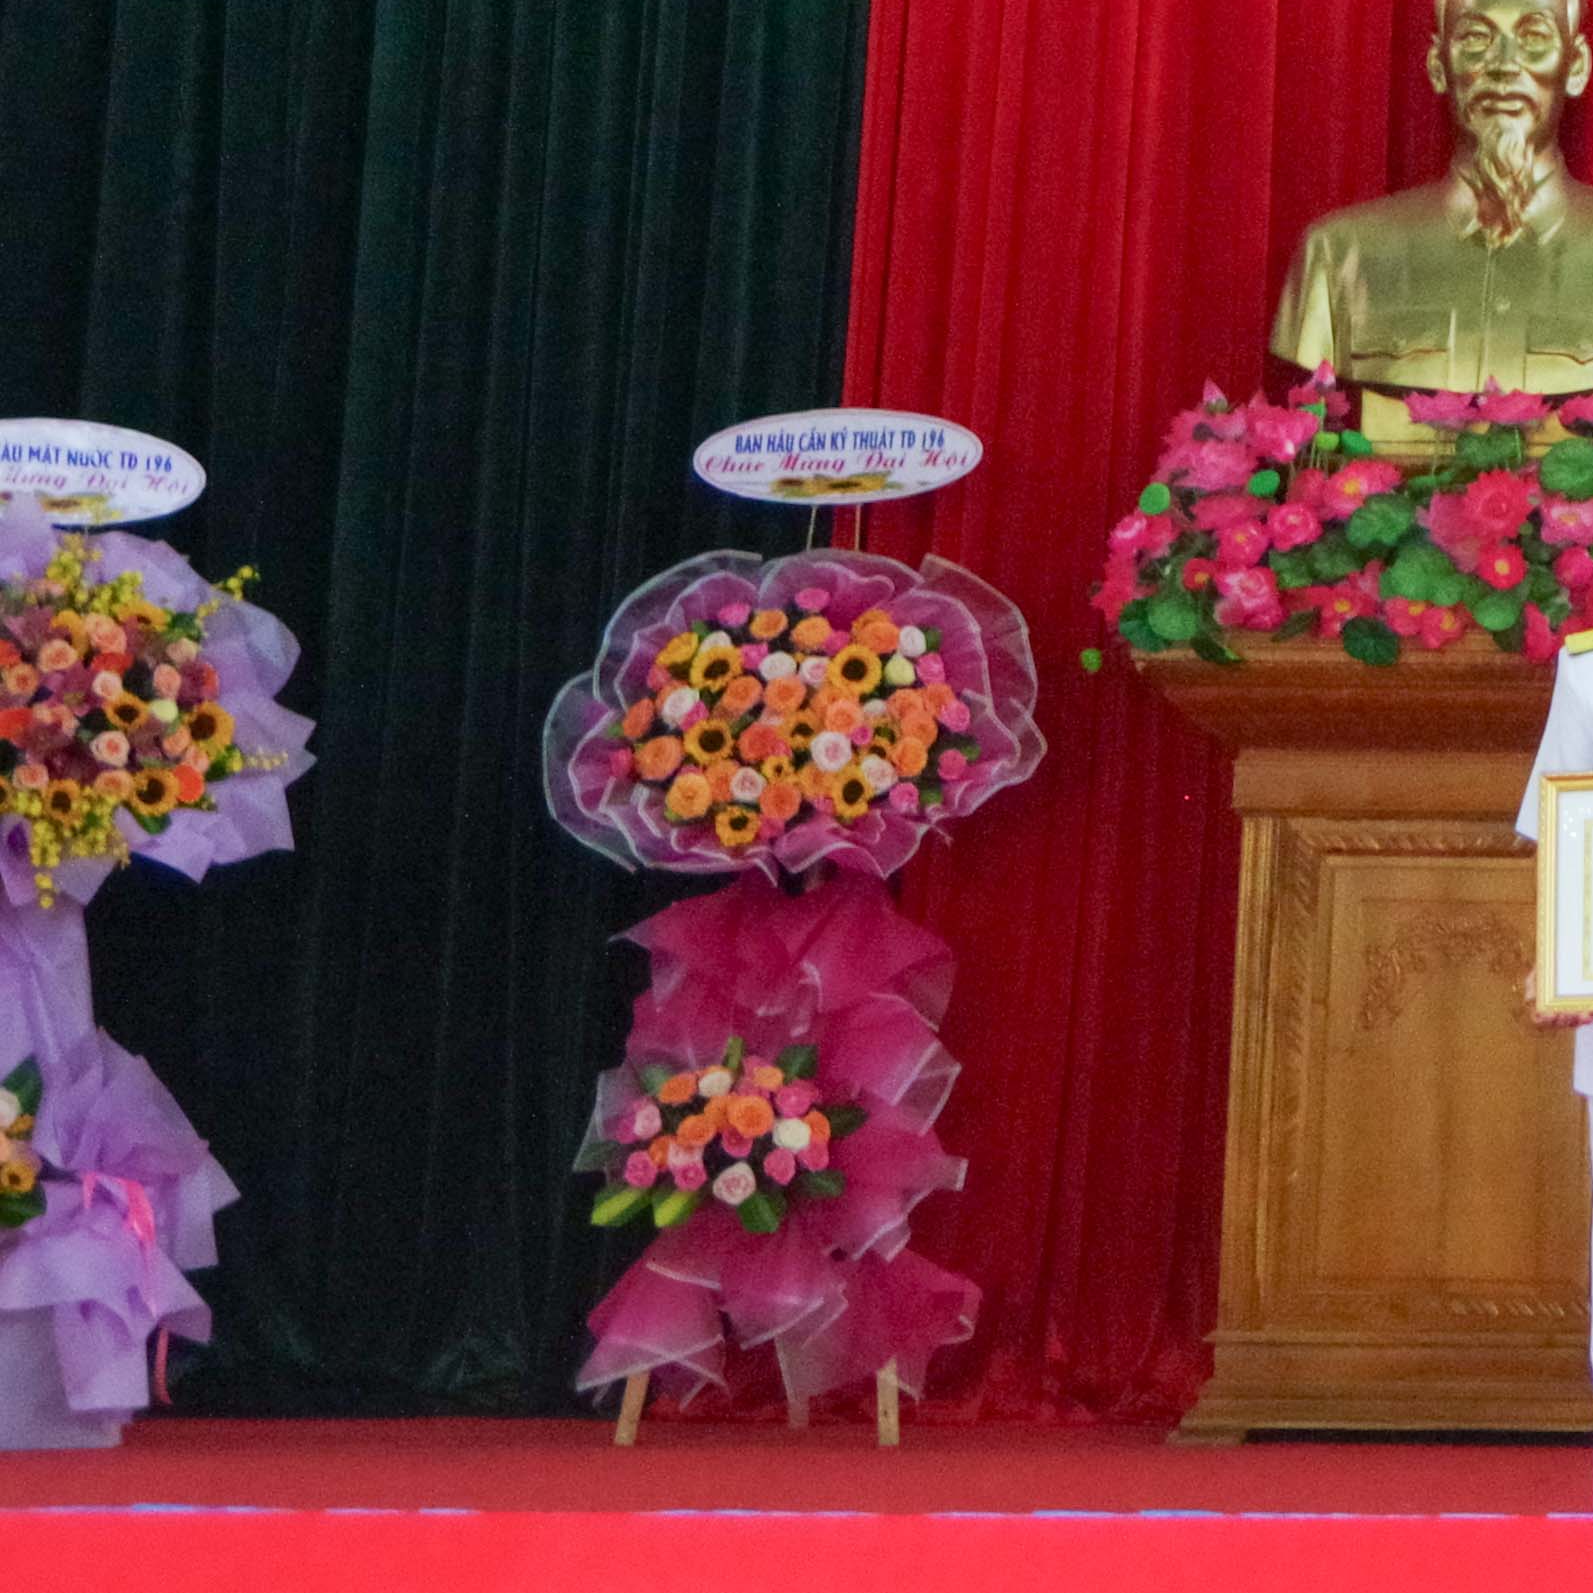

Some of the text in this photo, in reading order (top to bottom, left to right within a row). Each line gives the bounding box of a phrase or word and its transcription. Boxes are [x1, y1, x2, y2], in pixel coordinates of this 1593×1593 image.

[735, 433, 762, 454] BAN
[921, 427, 945, 453] 196
[145, 454, 173, 473] 196
